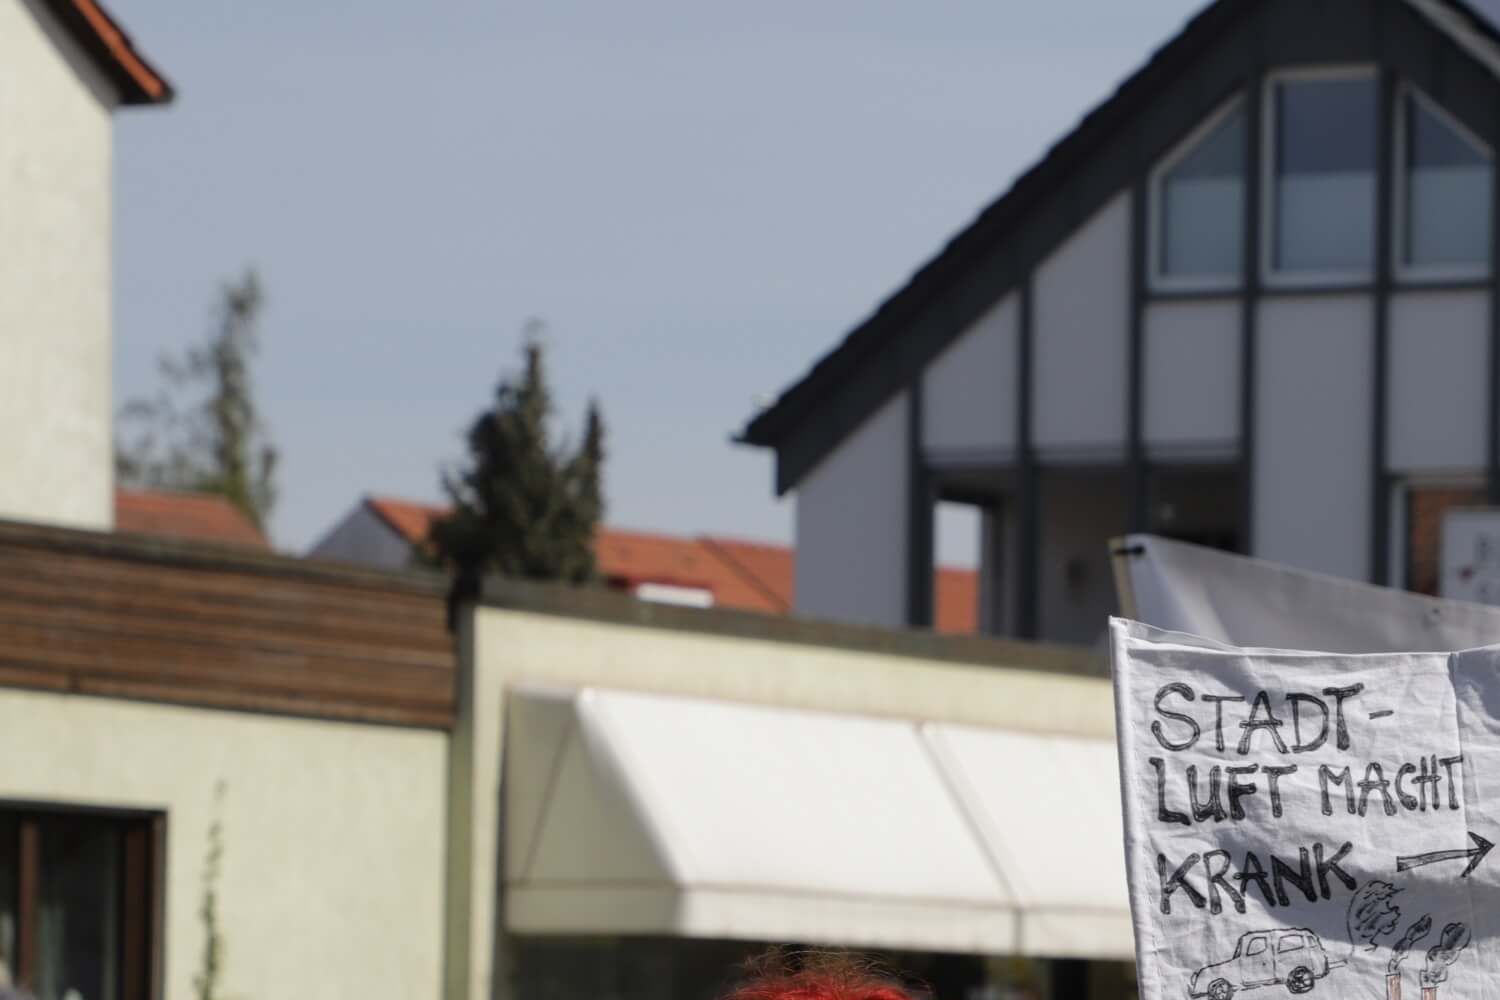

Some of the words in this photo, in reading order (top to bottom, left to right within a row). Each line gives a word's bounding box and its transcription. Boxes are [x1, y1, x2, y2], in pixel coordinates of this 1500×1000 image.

[1151, 681, 1395, 755] STADT-
[1148, 755, 1298, 827] LUFT
[1317, 753, 1465, 817] MACHT
[1156, 841, 1357, 916] KRANK
